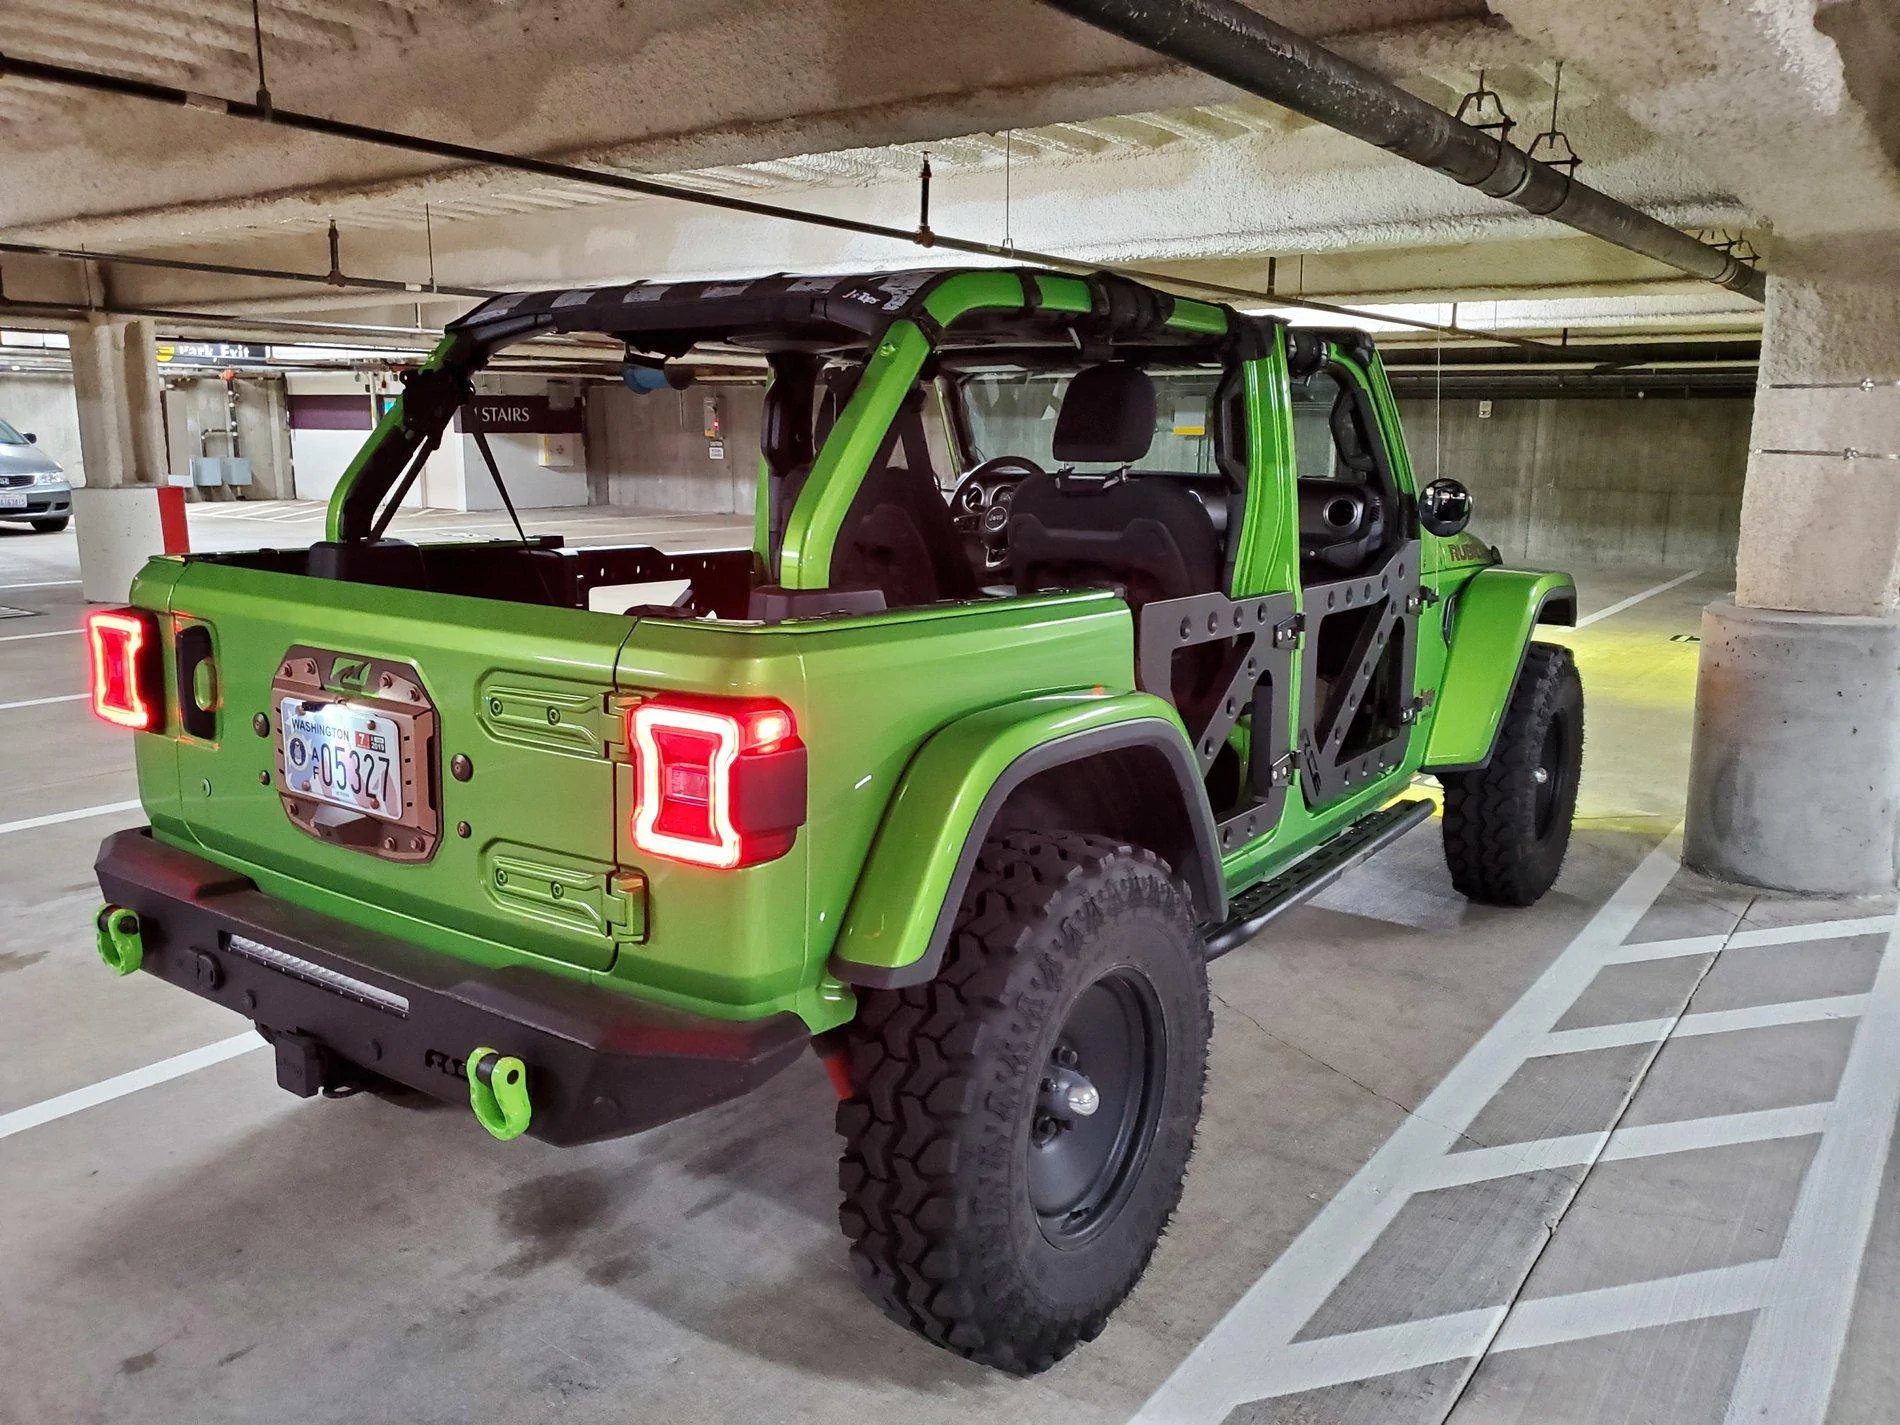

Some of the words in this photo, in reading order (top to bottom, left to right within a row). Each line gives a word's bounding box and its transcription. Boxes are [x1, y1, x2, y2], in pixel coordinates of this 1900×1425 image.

[179, 344, 213, 357] Park
[220, 344, 249, 358] Exit
[481, 407, 530, 422] STAIRS
[292, 718, 349, 742] WASHINGTON
[358, 733, 365, 745] 7
[320, 743, 390, 802] 05327
